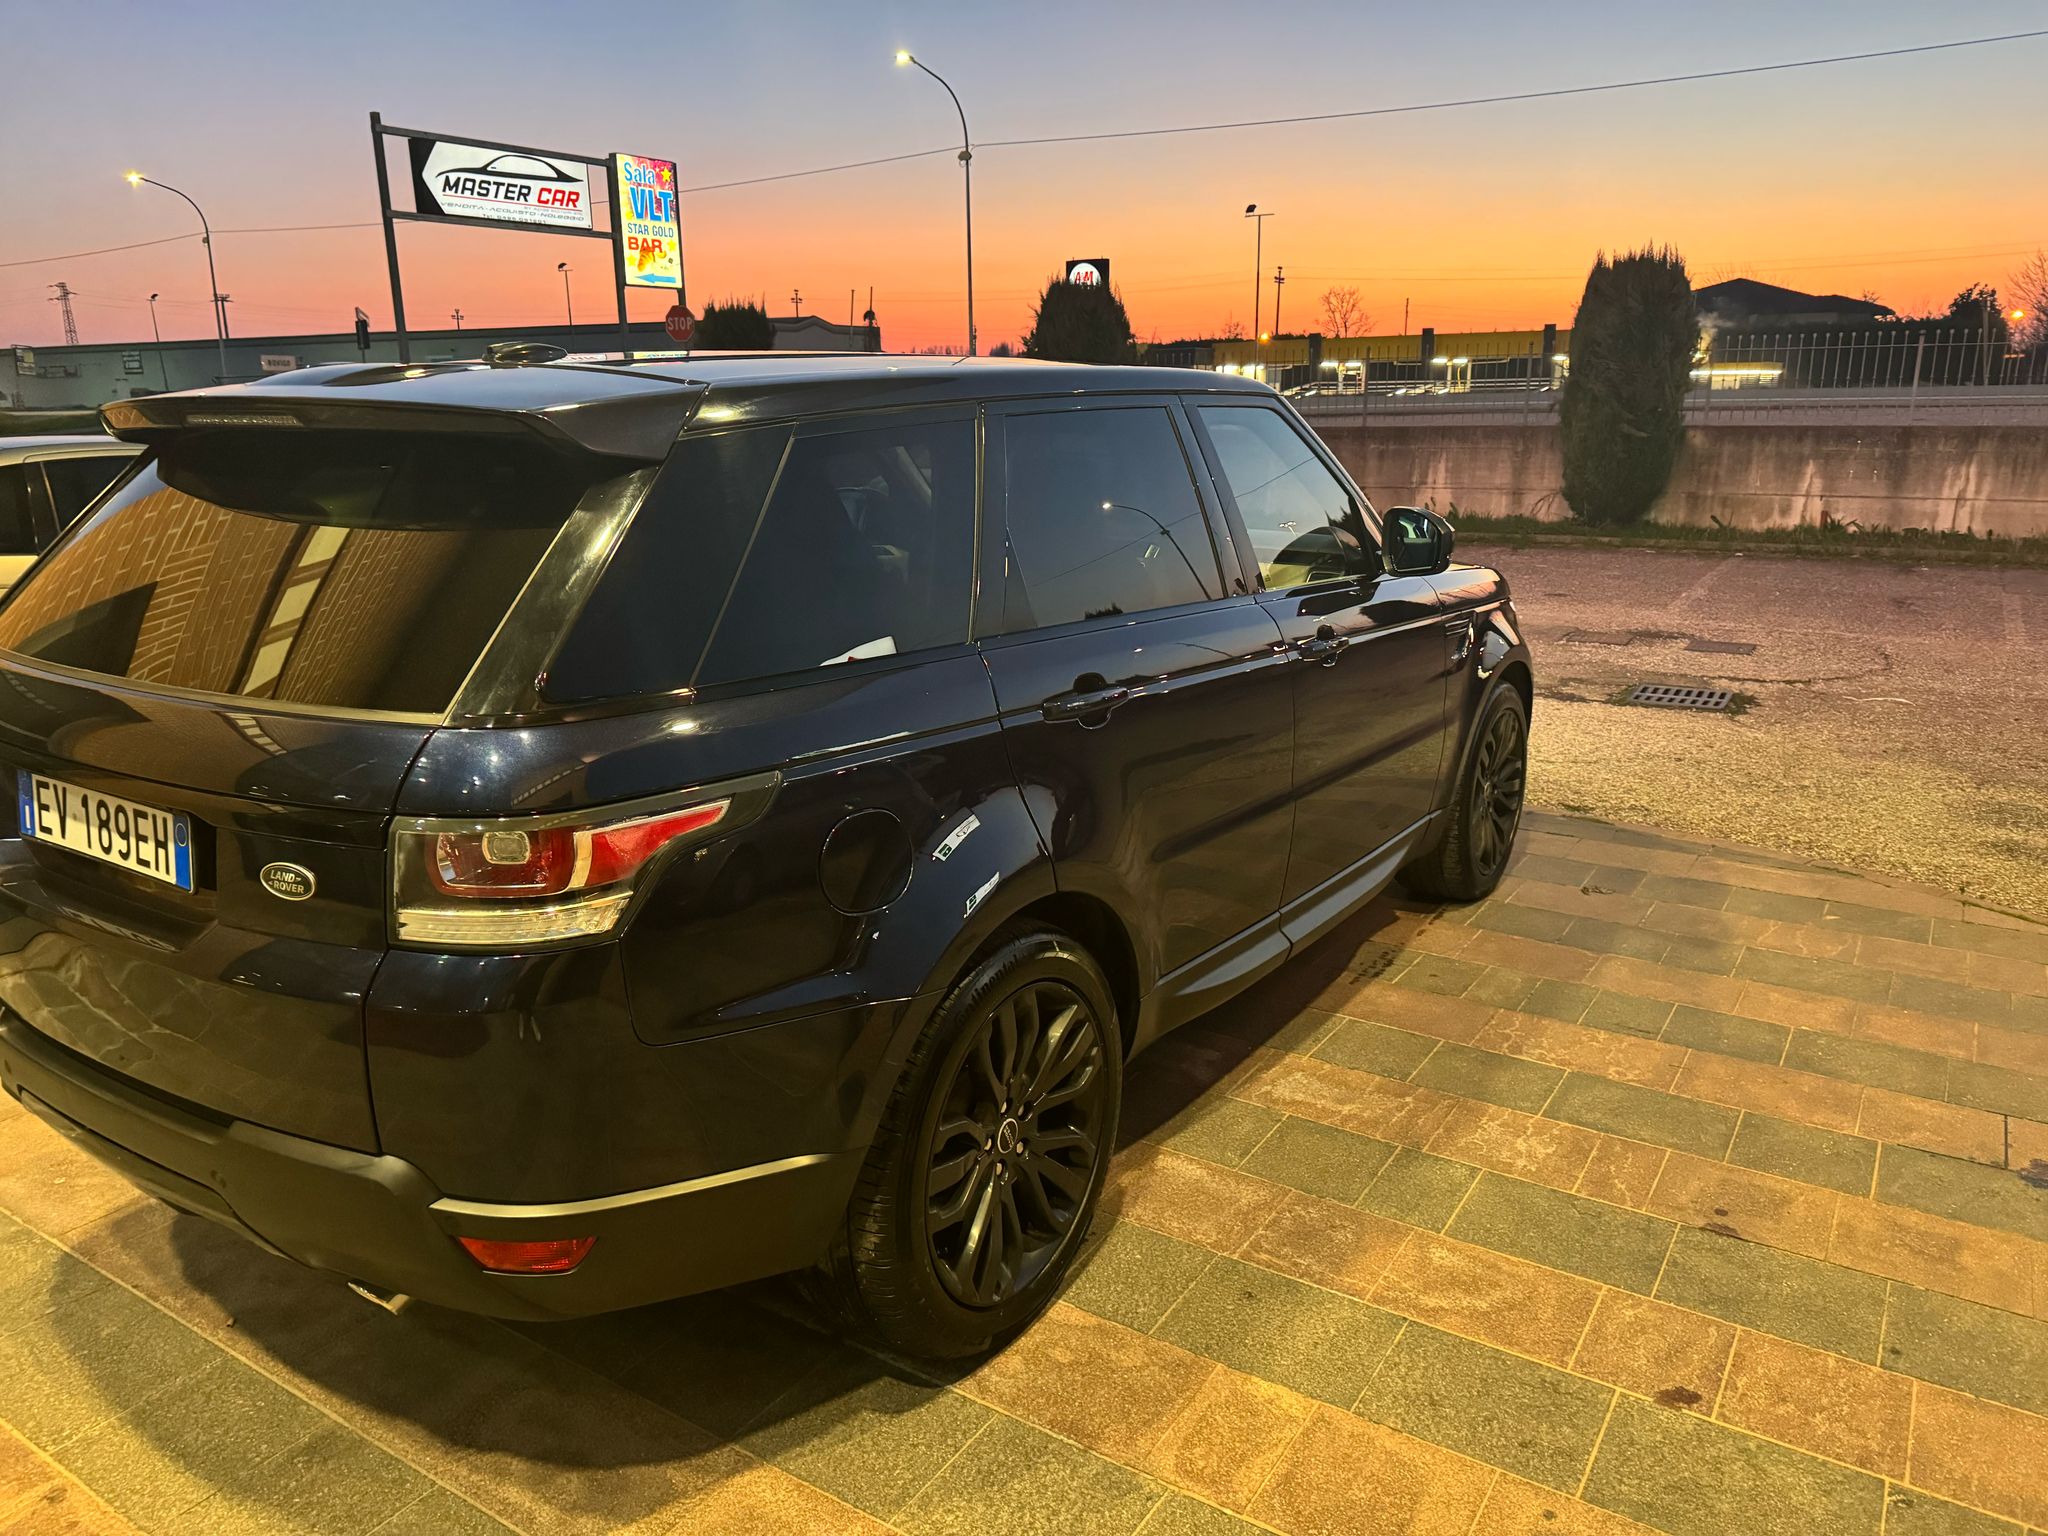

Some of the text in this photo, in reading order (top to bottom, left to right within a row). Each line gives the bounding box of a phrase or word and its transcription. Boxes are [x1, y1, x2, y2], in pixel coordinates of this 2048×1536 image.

[623, 162, 655, 185] Sala
[442, 175, 580, 208] MASTER CAR
[629, 186, 673, 222] VLT
[628, 223, 674, 238] STAR GOLD
[628, 236, 663, 252] BAR
[667, 316, 693, 330] STOP
[35, 780, 171, 876] EV 189EH
